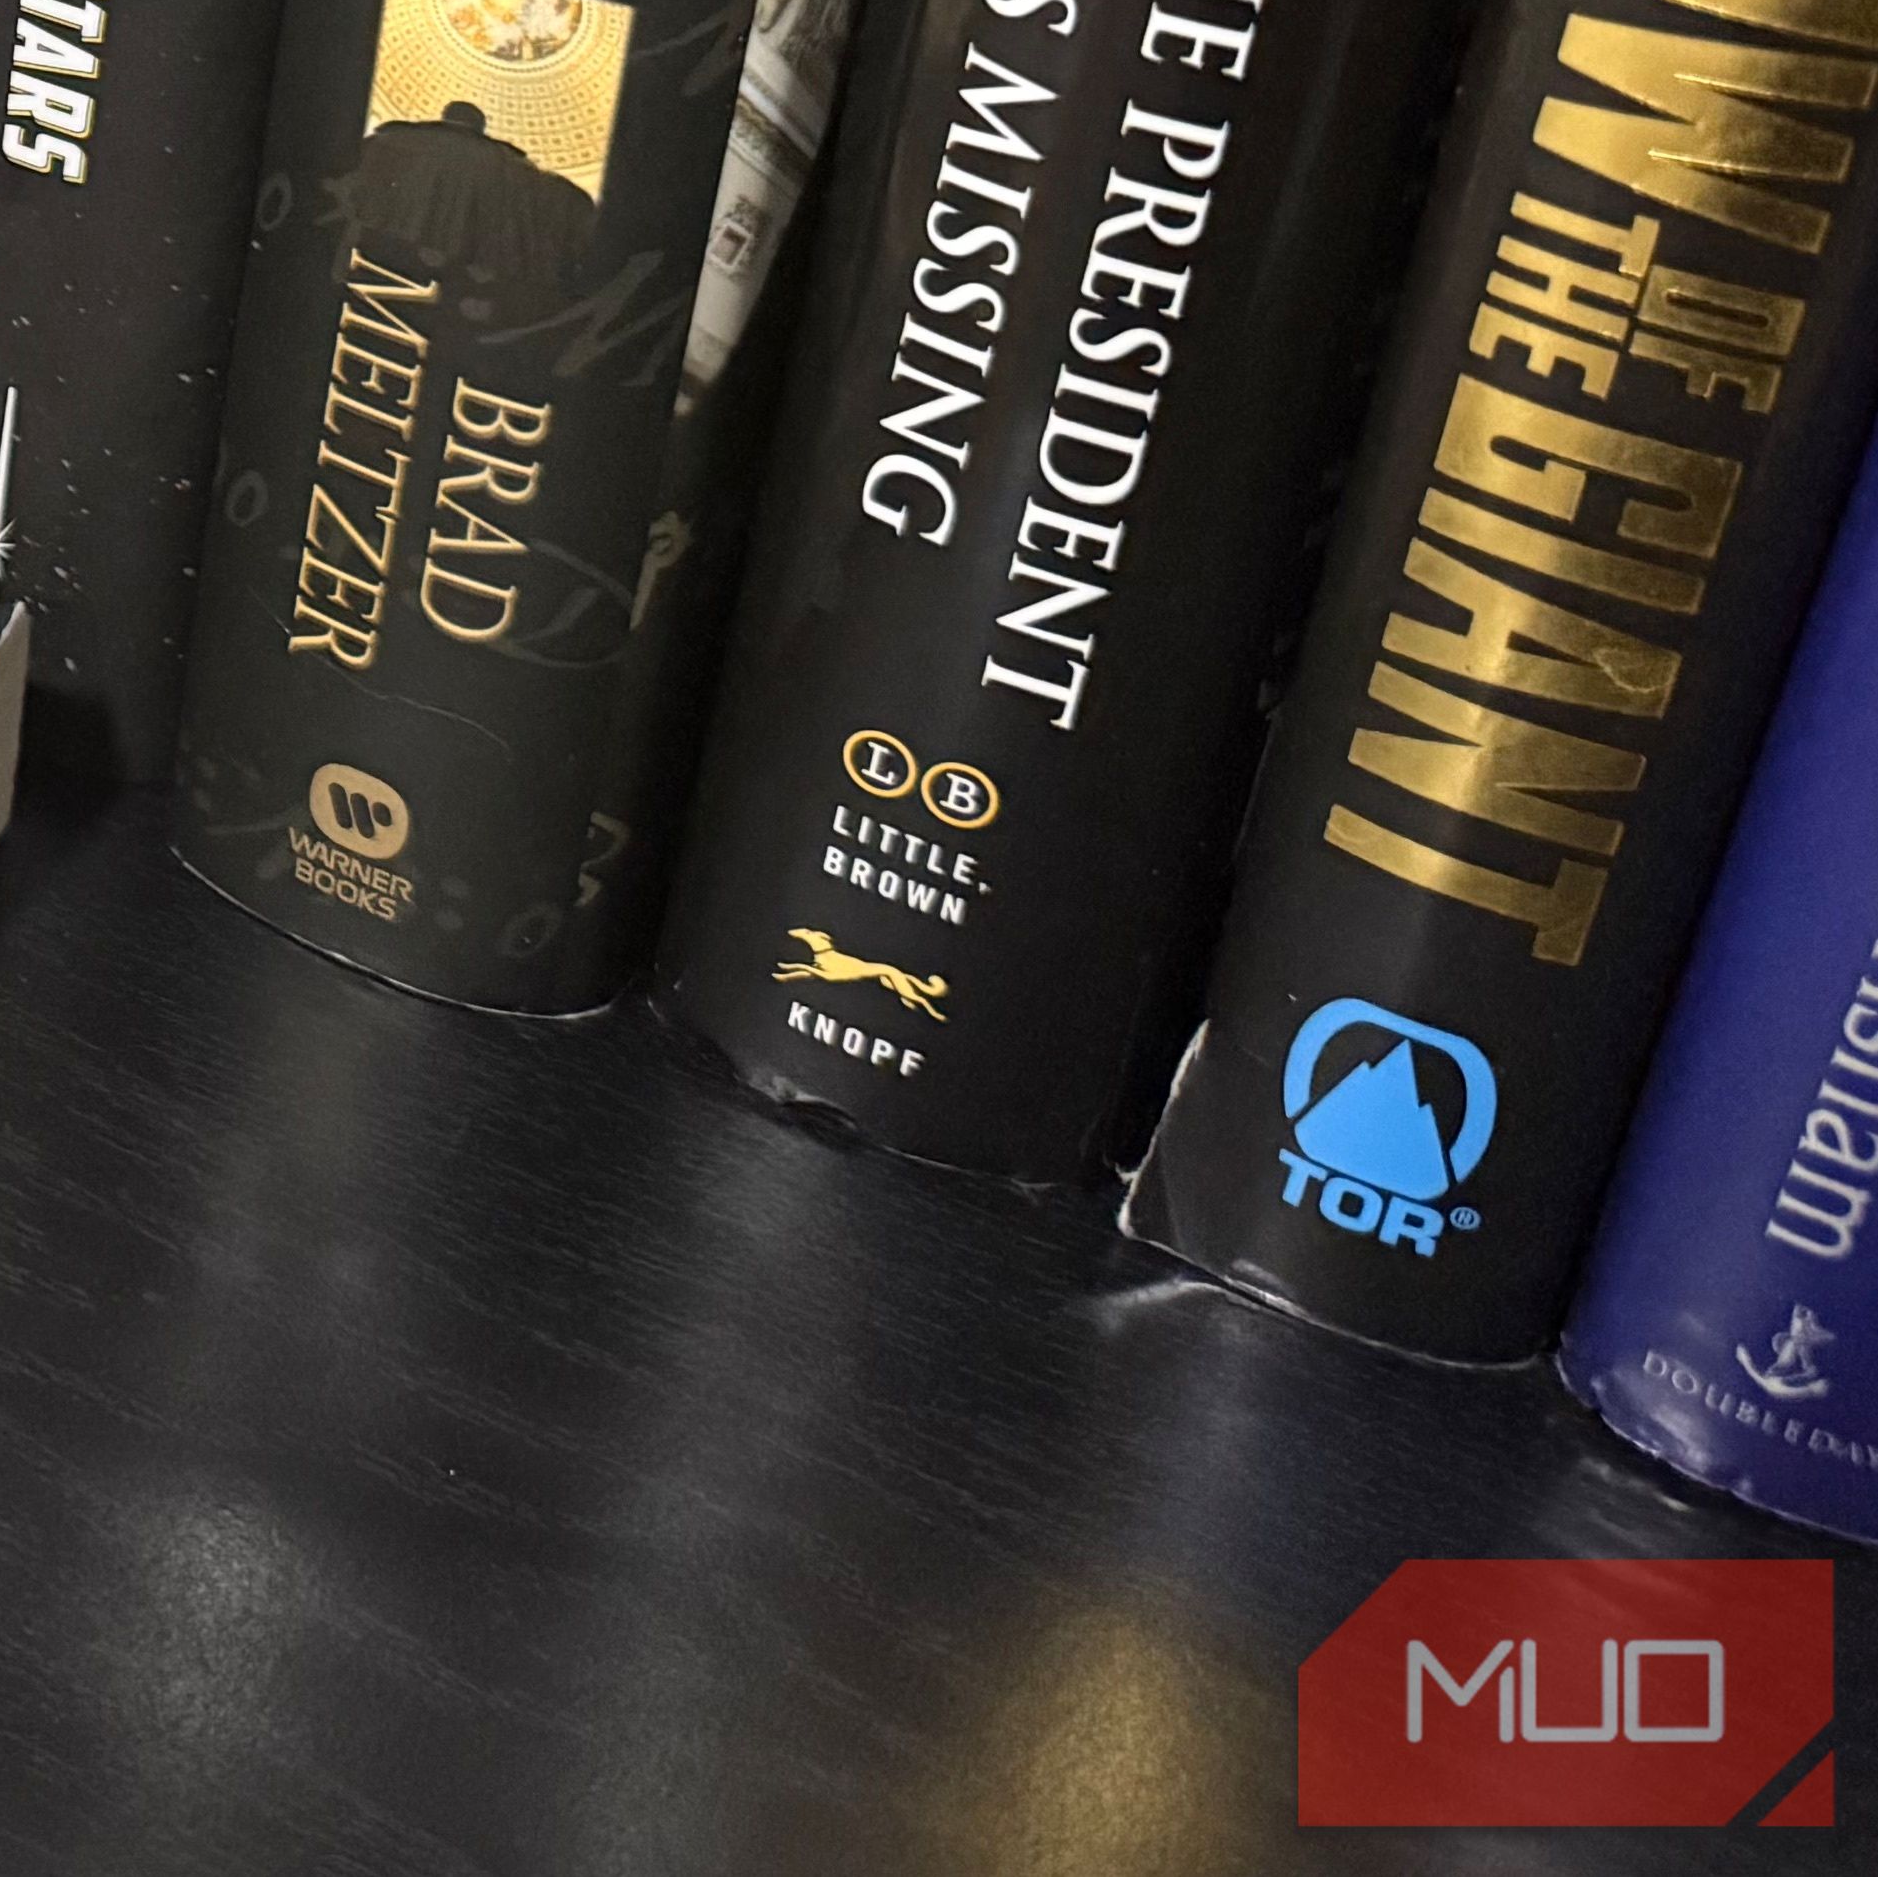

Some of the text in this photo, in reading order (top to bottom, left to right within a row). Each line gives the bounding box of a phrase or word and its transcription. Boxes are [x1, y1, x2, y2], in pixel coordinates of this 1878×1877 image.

[861, 41, 1061, 548] MISSING
[1467, 191, 1661, 400] THE
[1628, 262, 1806, 414] OF
[287, 247, 441, 672] MELTZER
[980, 98, 1231, 731] PRESIDENT
[418, 375, 551, 645] BRAD
[1323, 372, 1743, 967] GIANT
[832, 805, 993, 895] LITTLE,
[861, 741, 982, 815] L B
[289, 827, 413, 902] WARNER
[295, 857, 397, 920] BOOKS
[823, 845, 967, 925] BROWN
[787, 1001, 927, 1078] KNOPF
